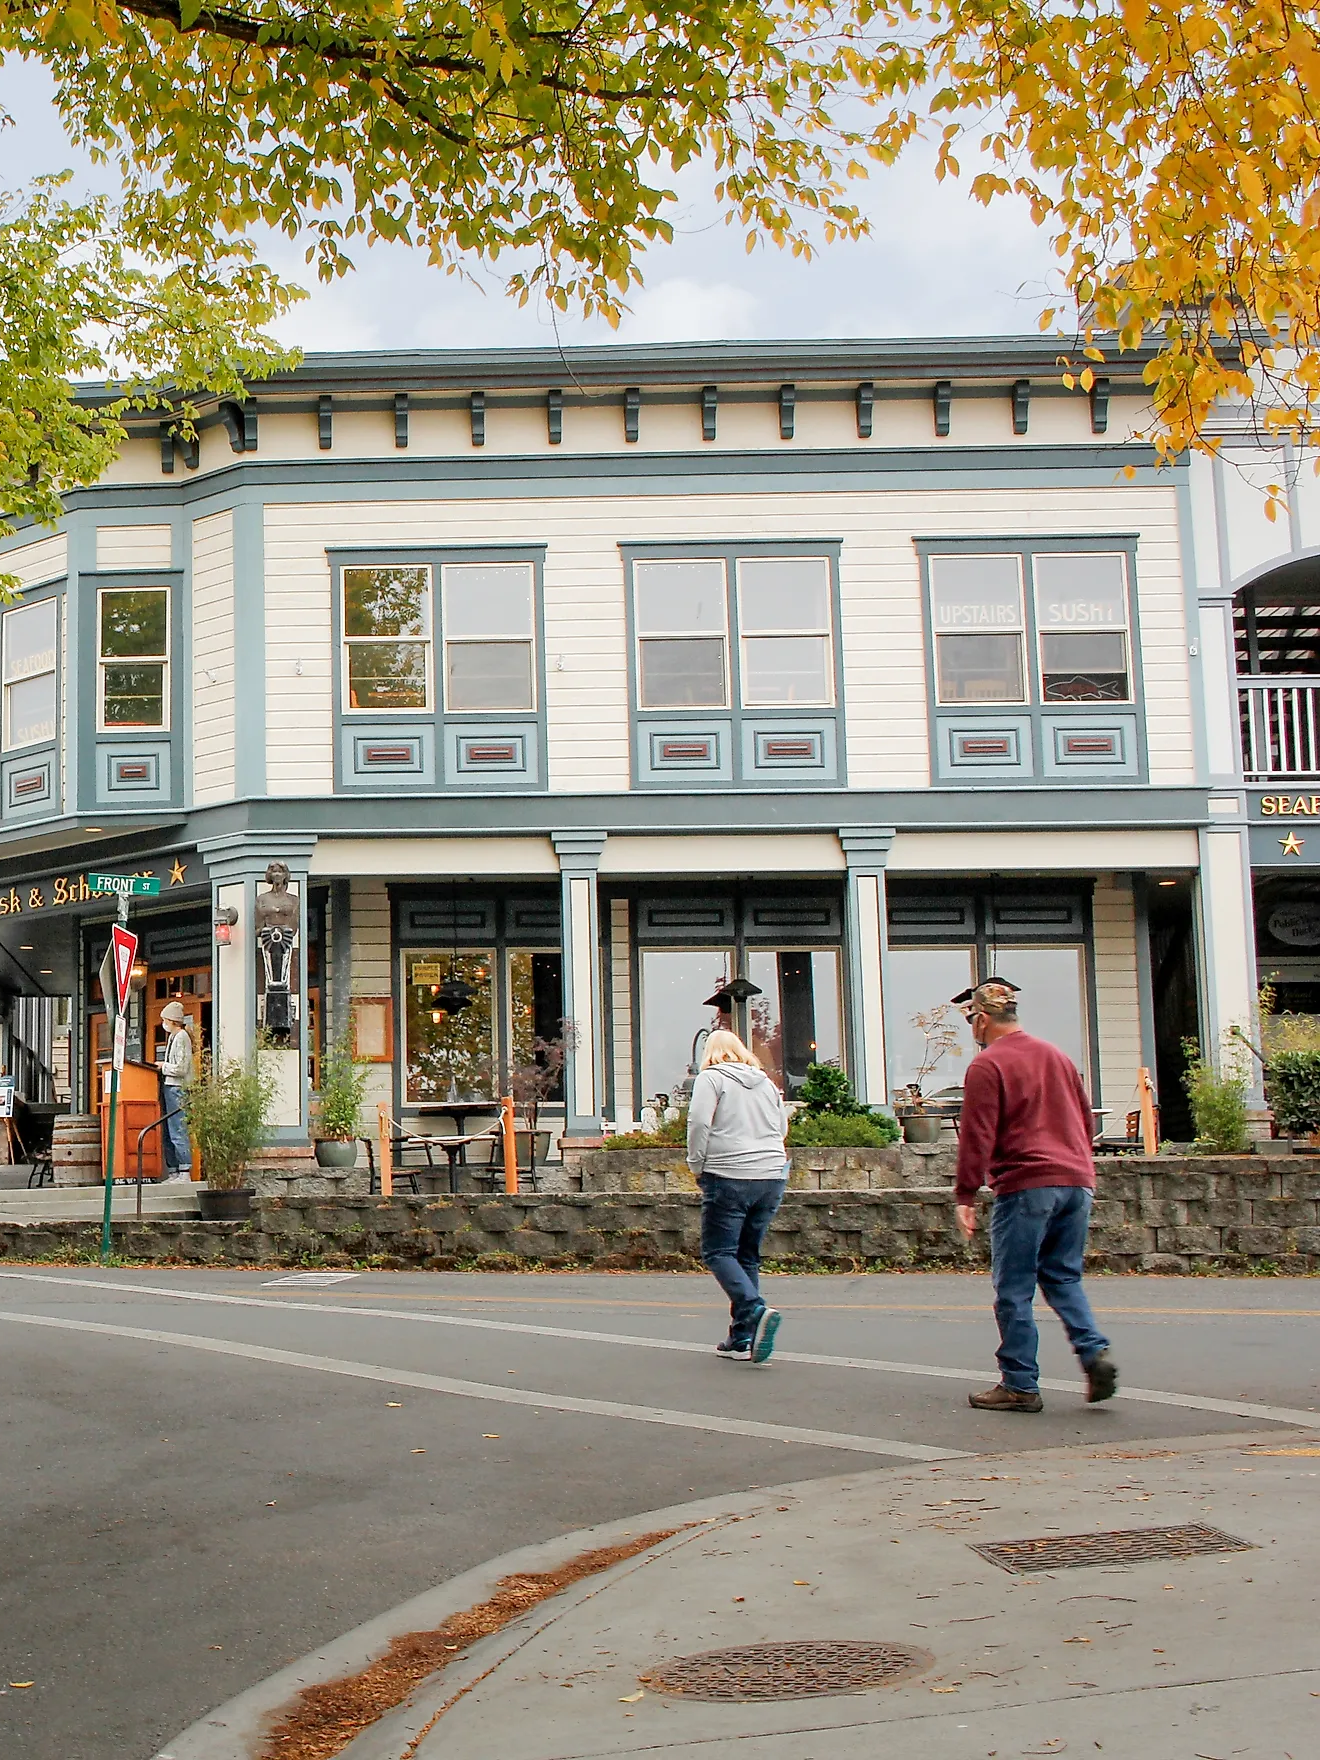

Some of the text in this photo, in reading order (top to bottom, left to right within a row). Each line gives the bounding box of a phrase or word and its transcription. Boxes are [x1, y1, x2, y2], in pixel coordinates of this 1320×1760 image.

[940, 603, 1114, 624] UPSTAIRS SUSHI
[97, 876, 151, 893] FRONT ST
[29, 887, 44, 908] &
